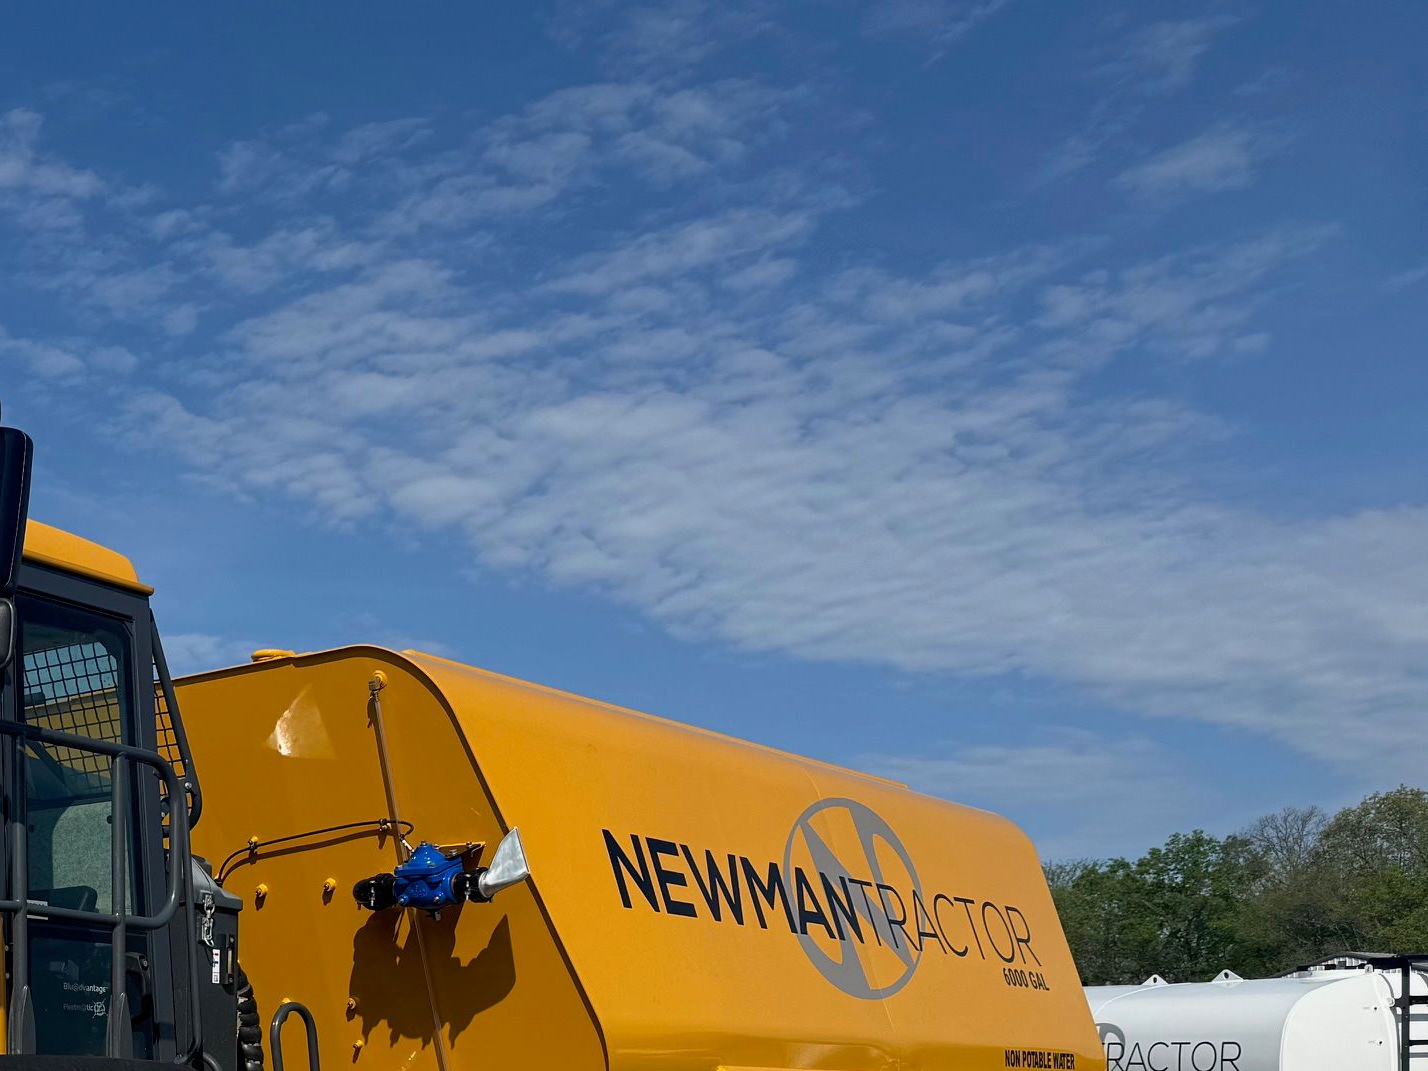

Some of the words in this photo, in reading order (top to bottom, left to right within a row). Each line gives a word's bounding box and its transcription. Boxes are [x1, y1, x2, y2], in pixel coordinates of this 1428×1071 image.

[1003, 967, 1029, 988] 6000
[1028, 971, 1050, 991] GAL
[1005, 1049, 1021, 1068] NON
[1022, 1050, 1052, 1070] POTABLE
[1052, 1052, 1075, 1070] WATER
